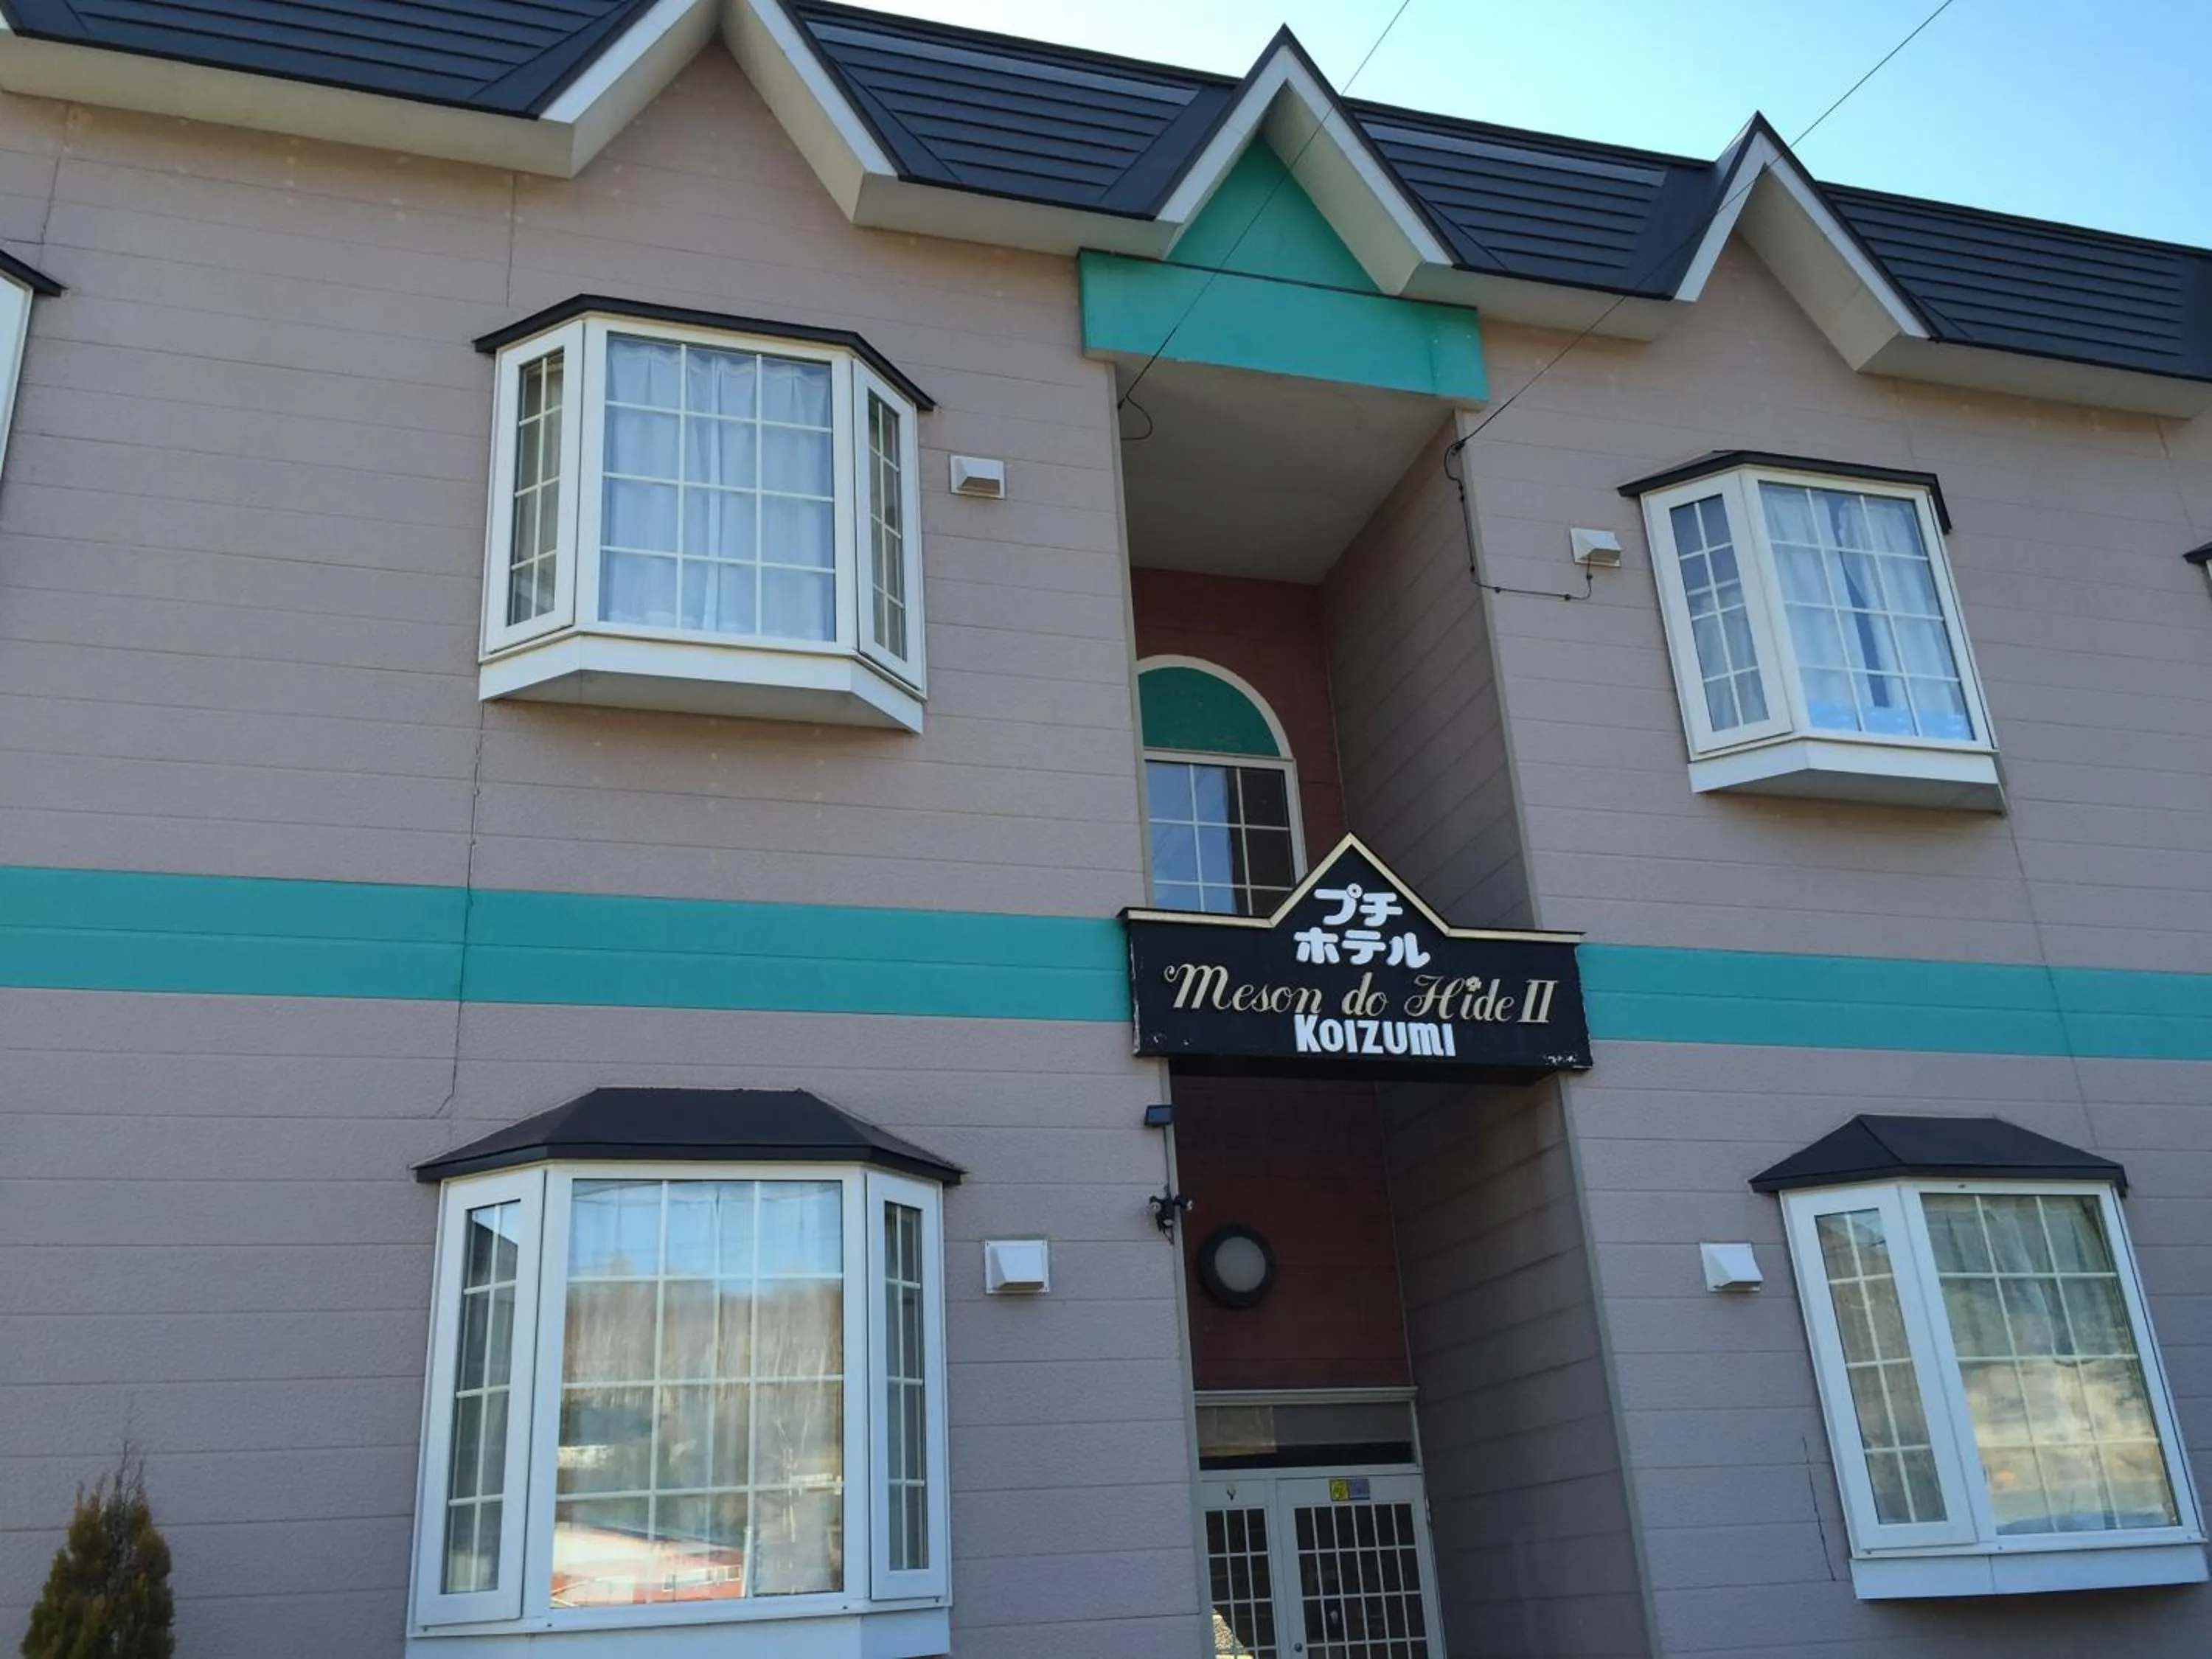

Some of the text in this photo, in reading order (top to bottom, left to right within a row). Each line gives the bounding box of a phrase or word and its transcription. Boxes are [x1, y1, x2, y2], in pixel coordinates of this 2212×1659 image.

[1314, 883, 1403, 926] プチ
[1293, 928, 1431, 969] ホテル
[1164, 963, 1322, 1014] Meson
[1403, 974, 1514, 1022] Hide
